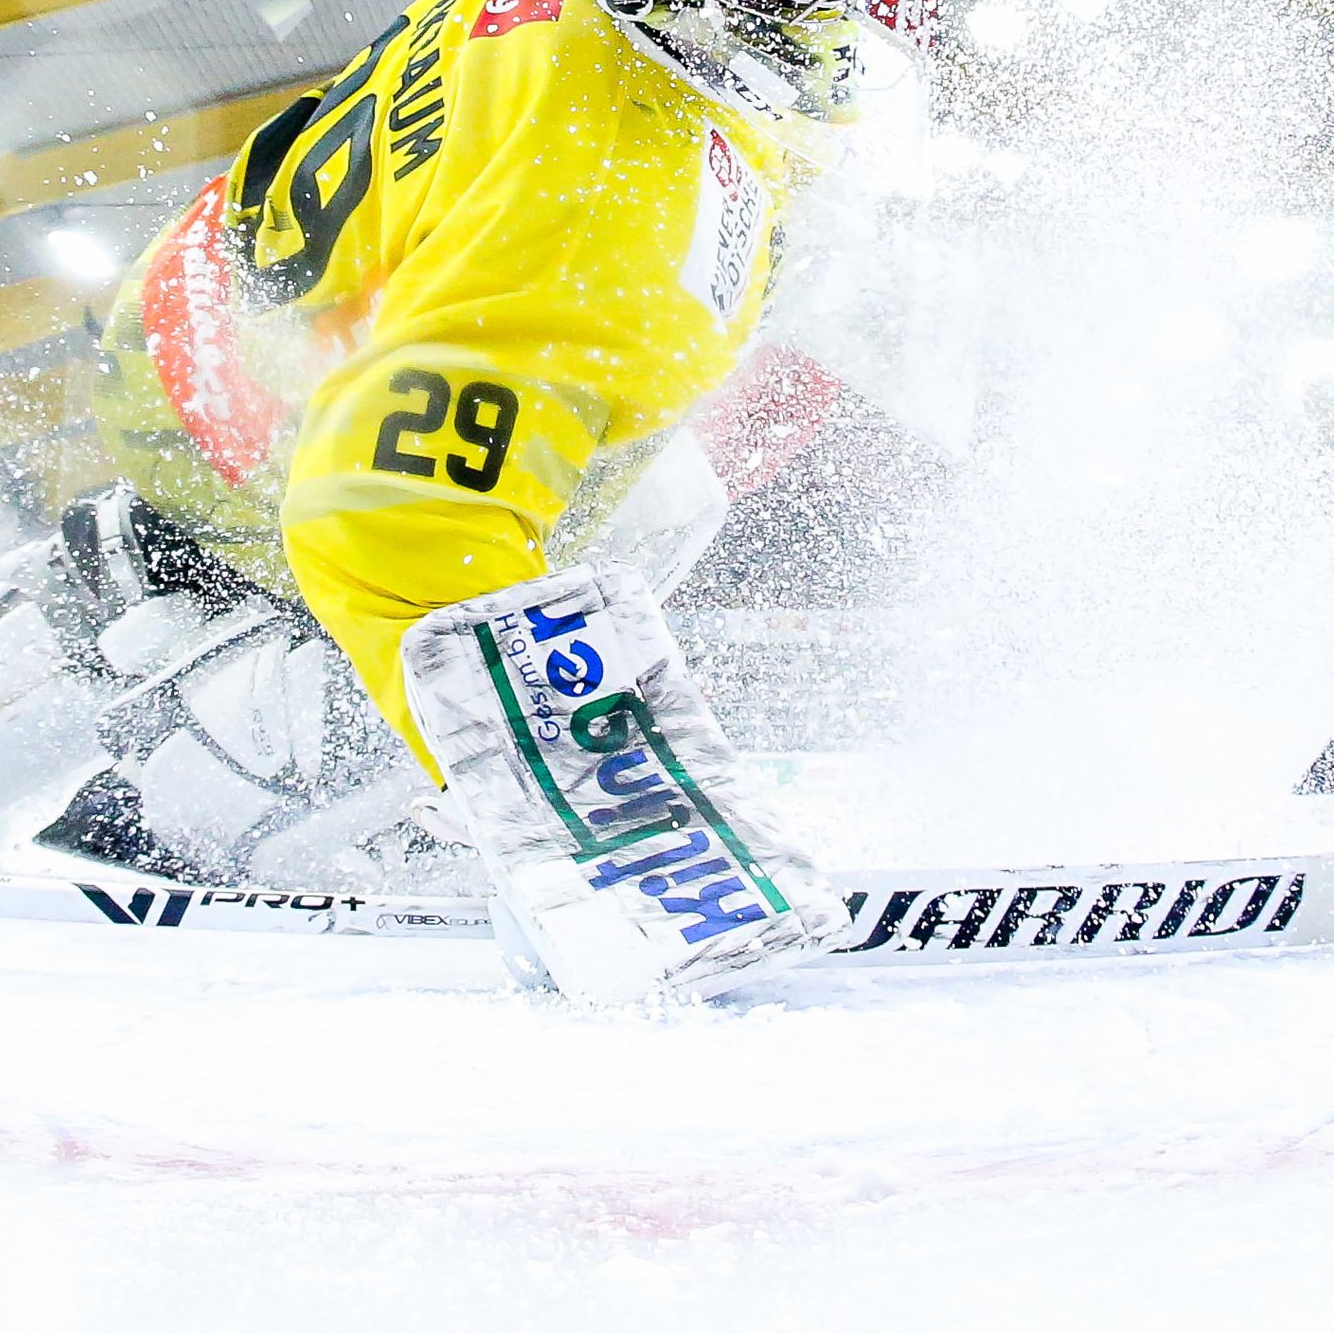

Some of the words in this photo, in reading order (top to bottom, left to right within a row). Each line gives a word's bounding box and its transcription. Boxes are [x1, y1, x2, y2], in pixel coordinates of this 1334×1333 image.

[372, 367, 519, 493] 29
[394, 914, 449, 926] VIBEX
[827, 872, 1306, 954] ARRIO
